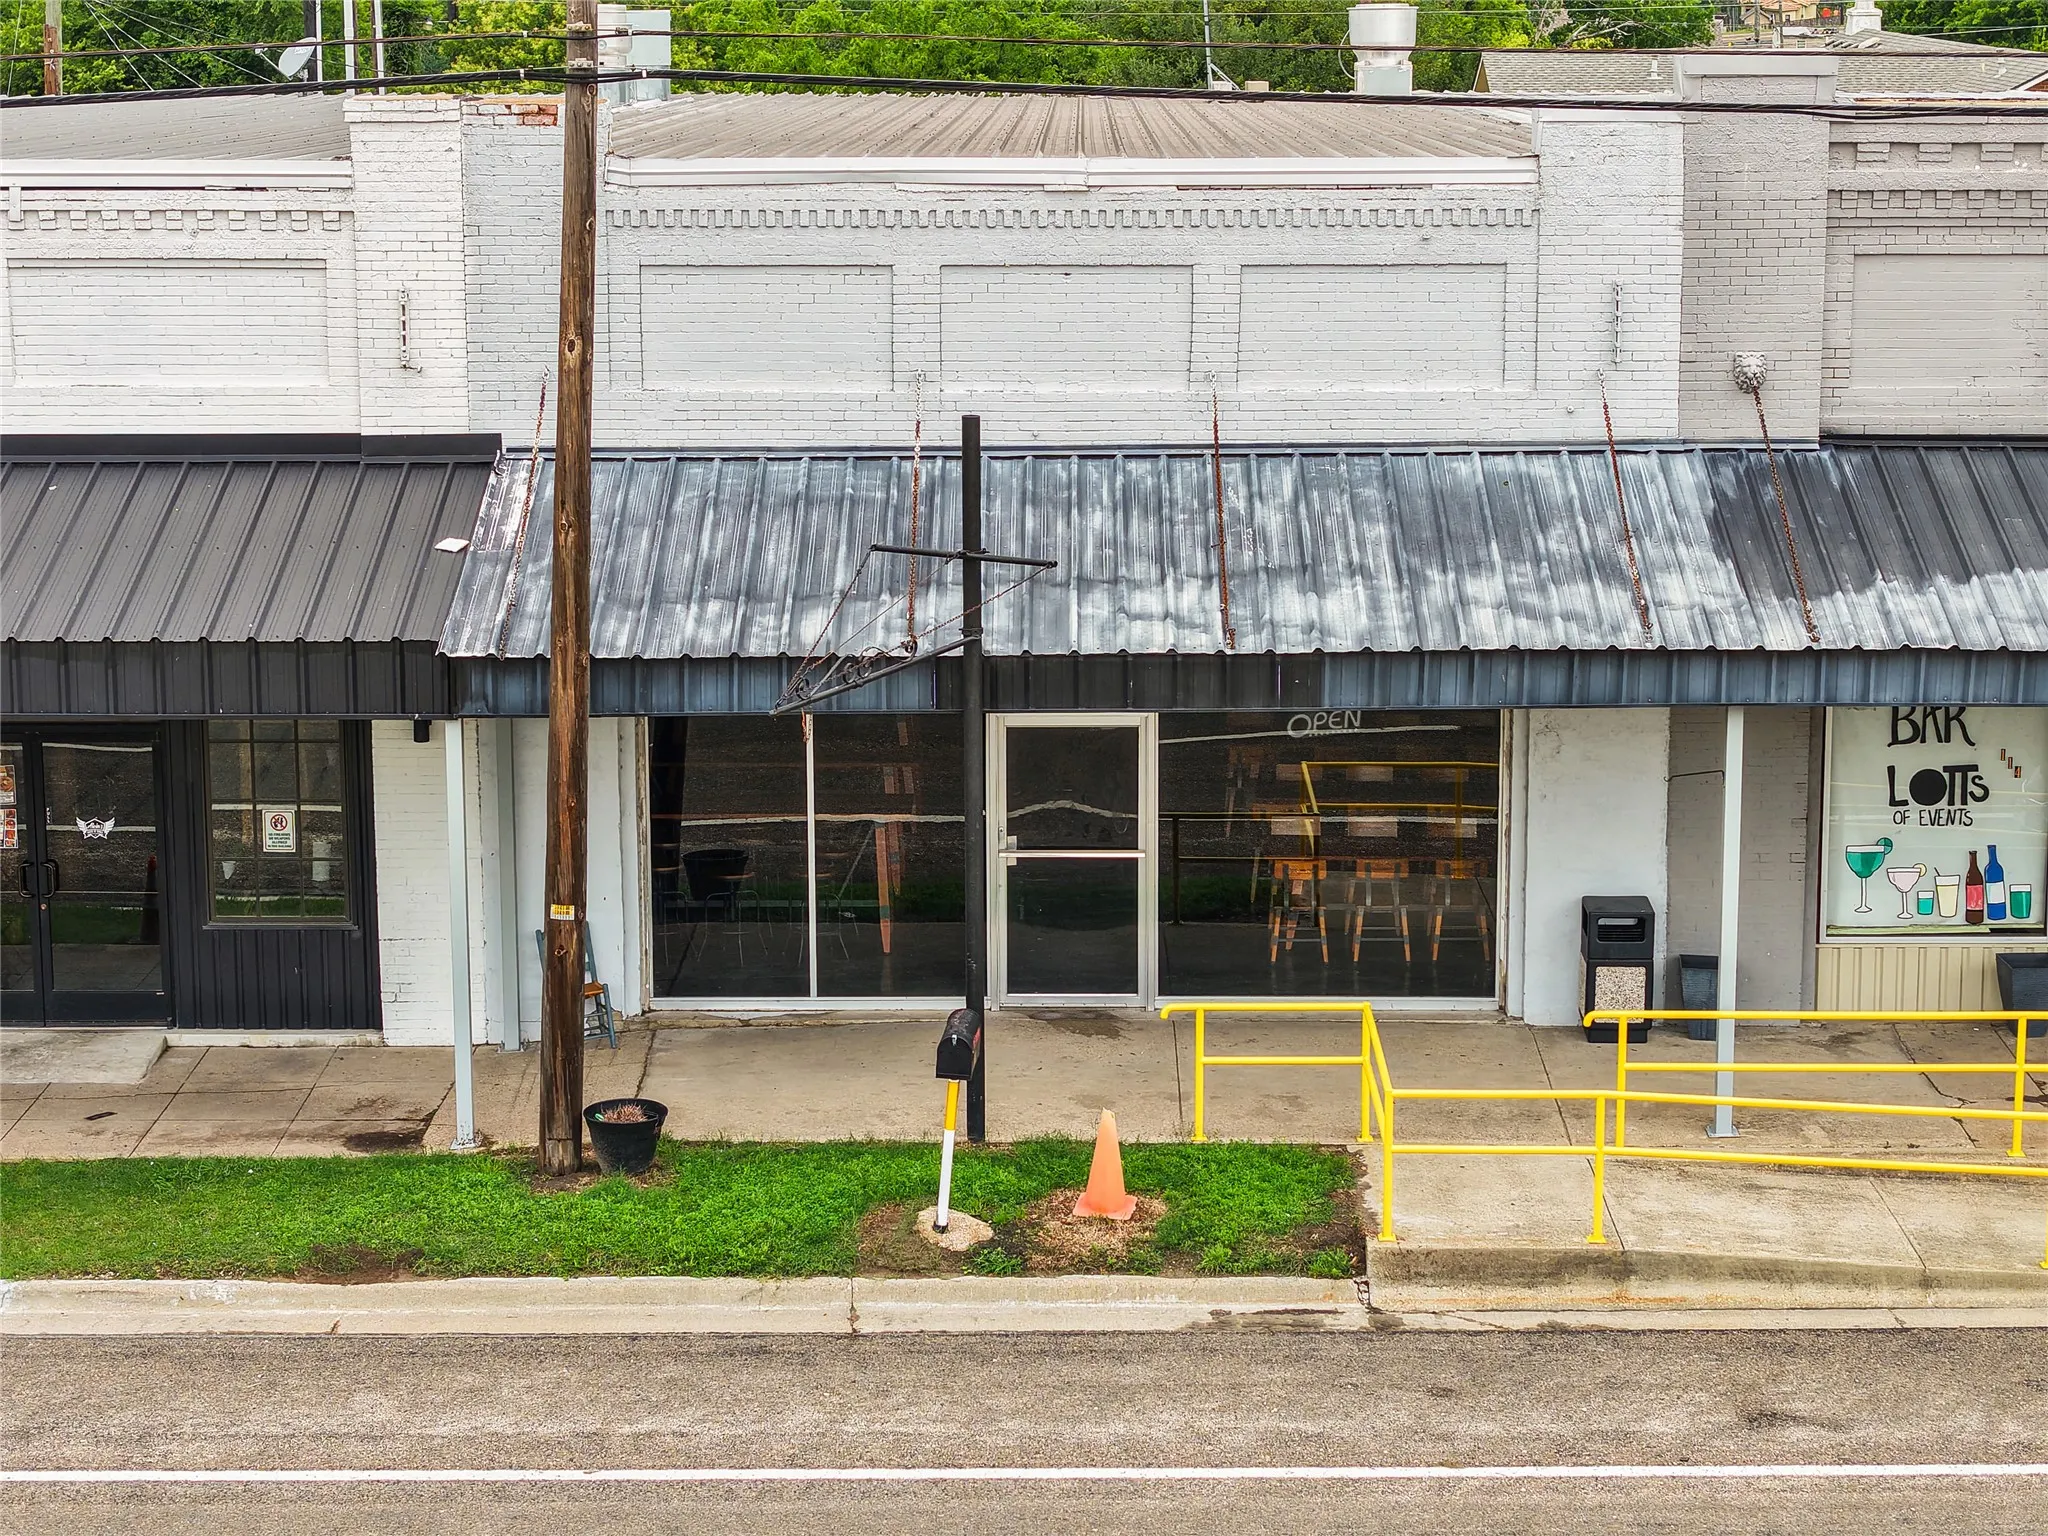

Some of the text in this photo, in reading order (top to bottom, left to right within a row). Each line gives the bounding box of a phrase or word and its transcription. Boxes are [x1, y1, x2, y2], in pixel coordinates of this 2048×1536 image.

[1286, 710, 1361, 738] OPEN
[1893, 808, 1974, 827] OF EVENTS
